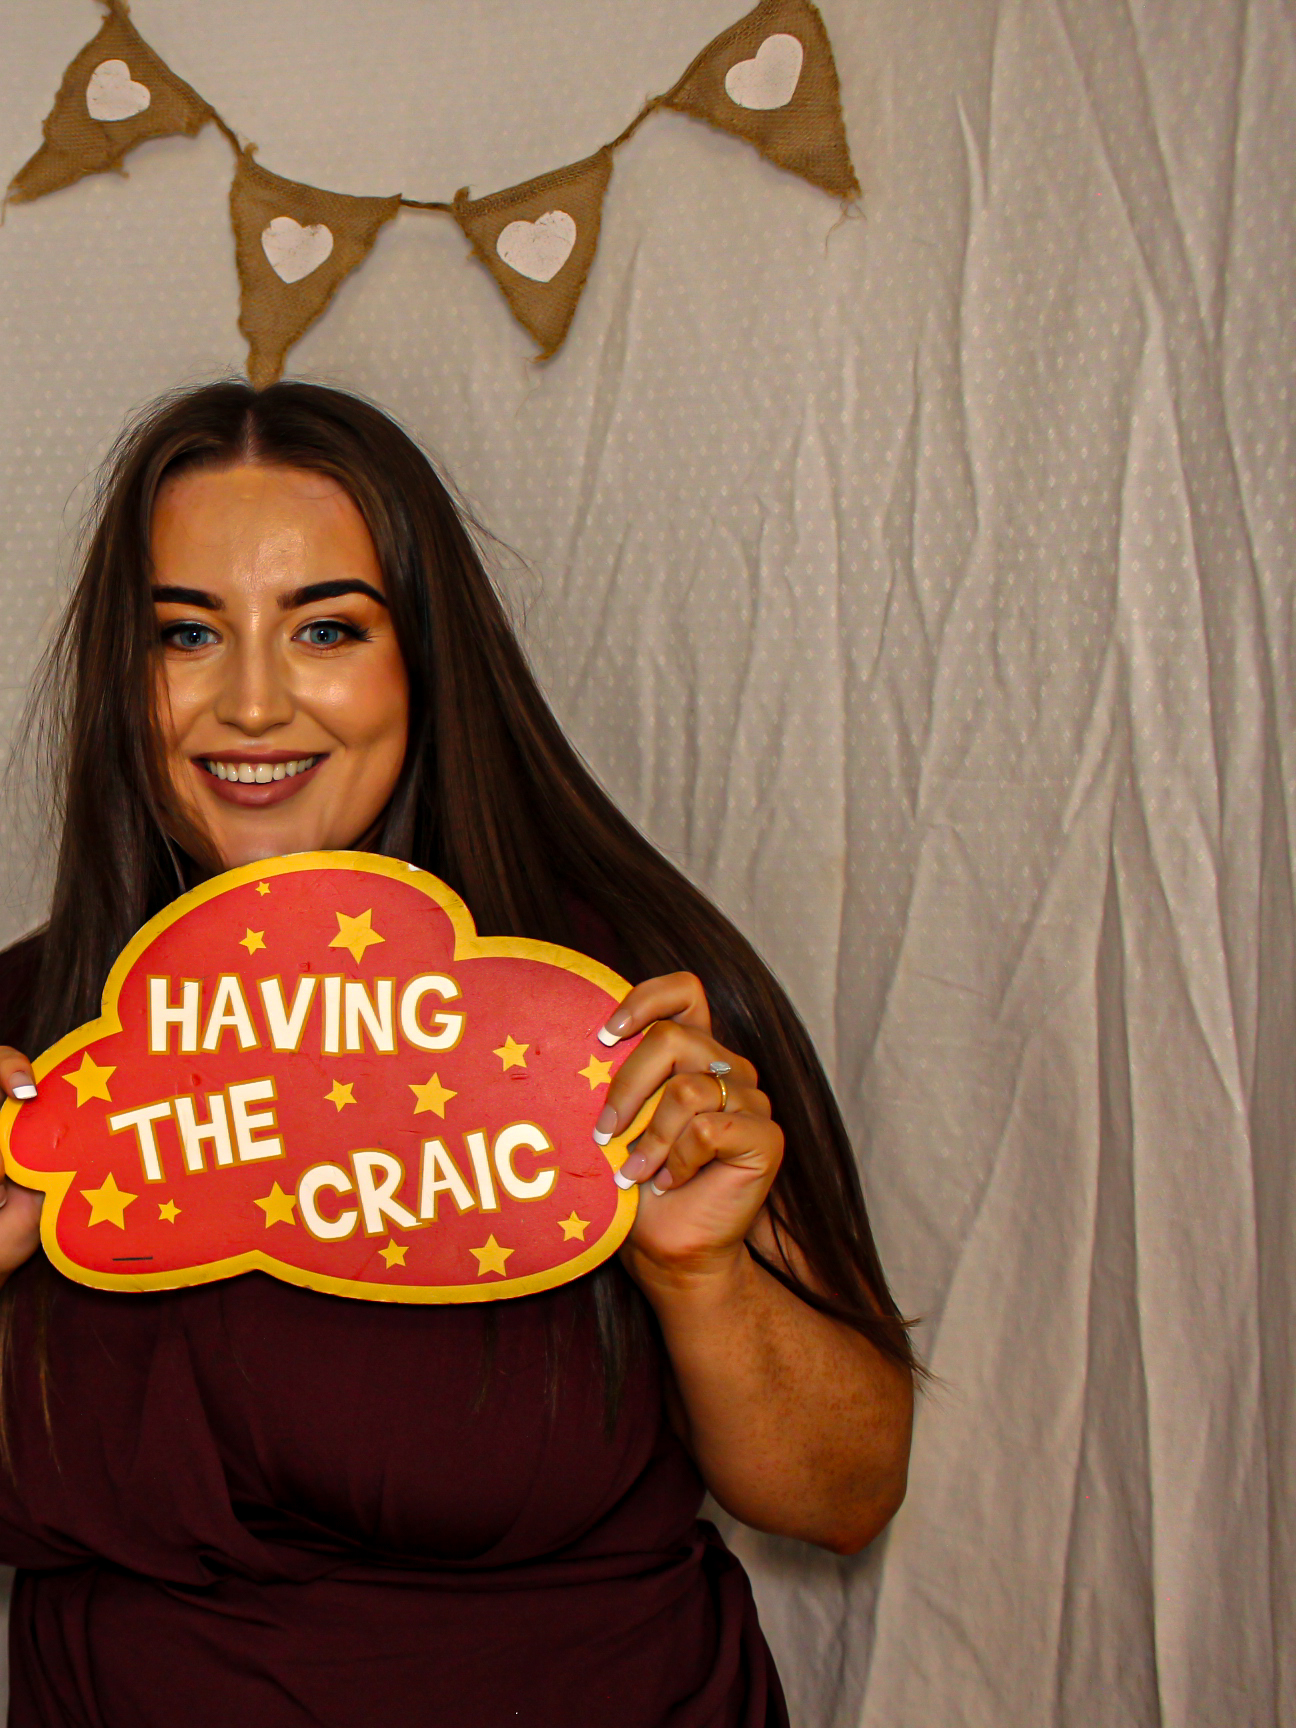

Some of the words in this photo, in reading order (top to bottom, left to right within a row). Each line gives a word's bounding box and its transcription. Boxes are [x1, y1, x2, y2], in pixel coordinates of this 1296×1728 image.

[147, 974, 465, 1056] HAVING
[108, 1077, 284, 1183] THE
[297, 1121, 558, 1241] CRAIC
